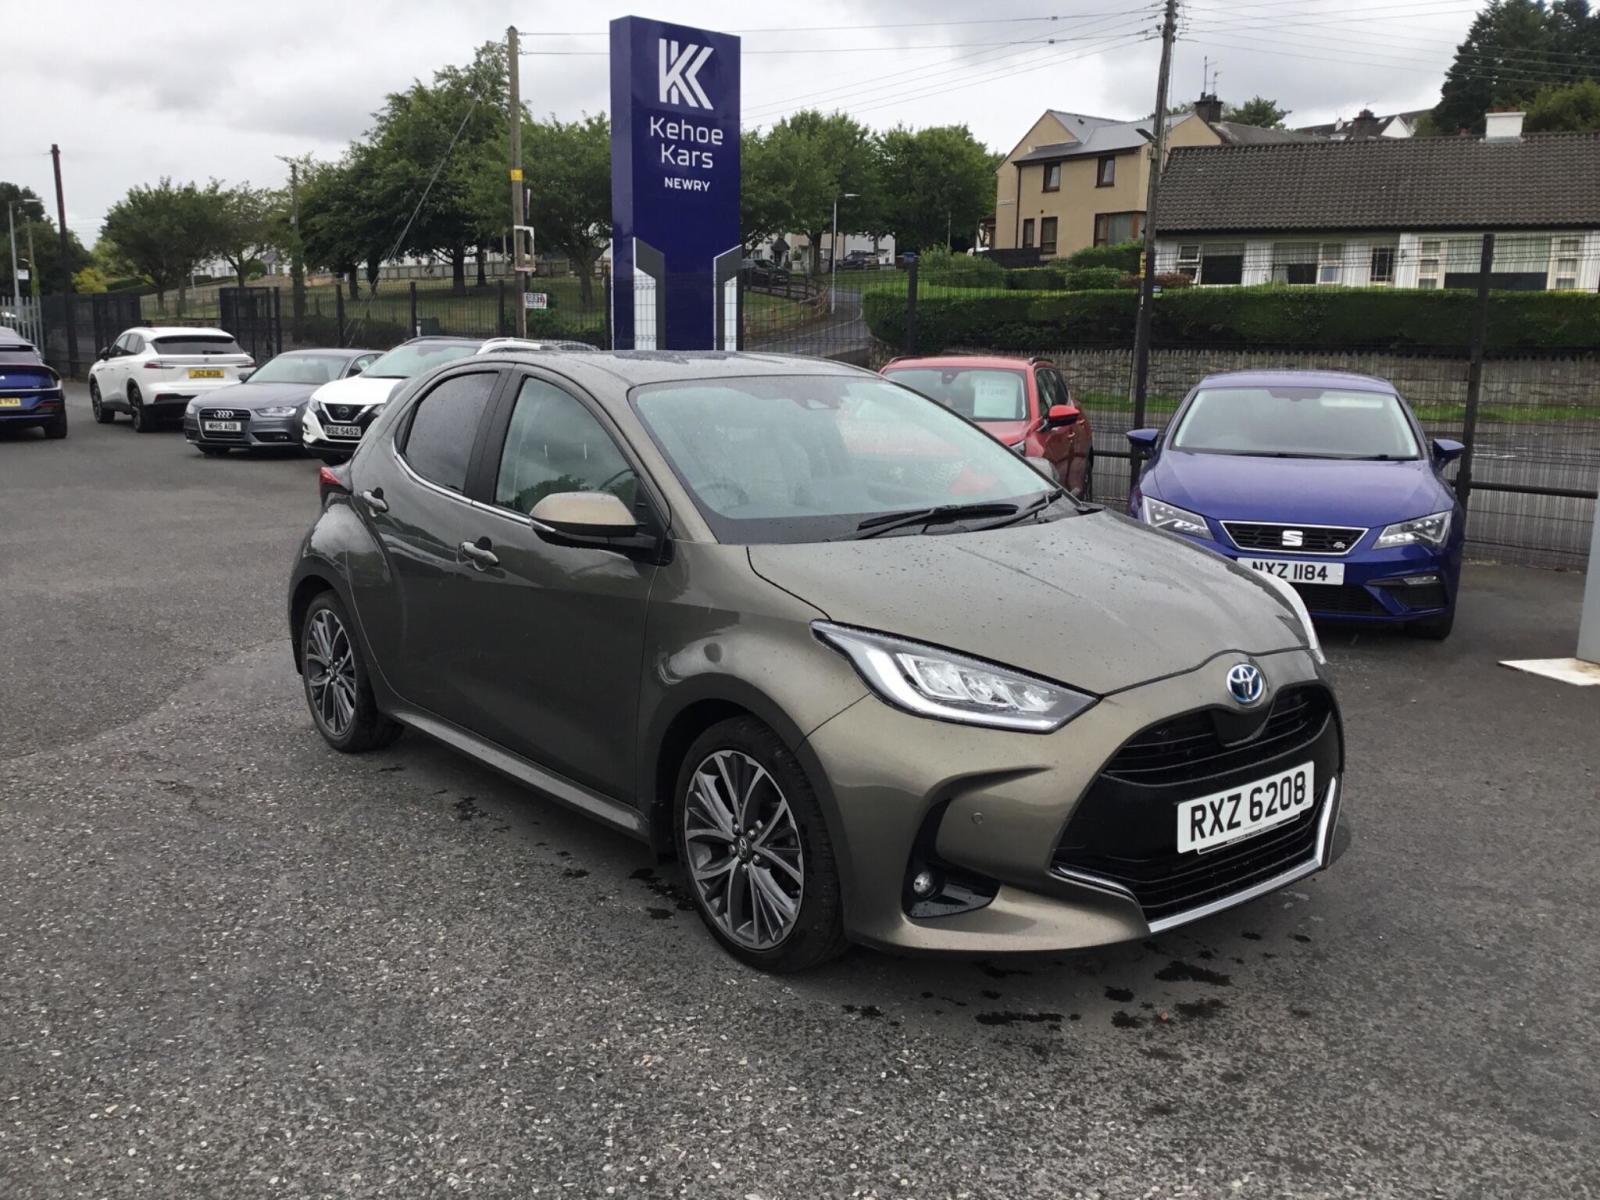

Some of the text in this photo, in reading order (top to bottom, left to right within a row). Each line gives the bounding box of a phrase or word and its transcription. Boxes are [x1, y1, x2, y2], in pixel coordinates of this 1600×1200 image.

[650, 116, 724, 145] Kehoe
[661, 143, 713, 168] Kars
[664, 177, 711, 192] NEWRY
[340, 427, 359, 435] 5452
[1293, 564, 1328, 581] 1184
[1190, 792, 1242, 842] RXZ
[1249, 770, 1306, 823] 6208
